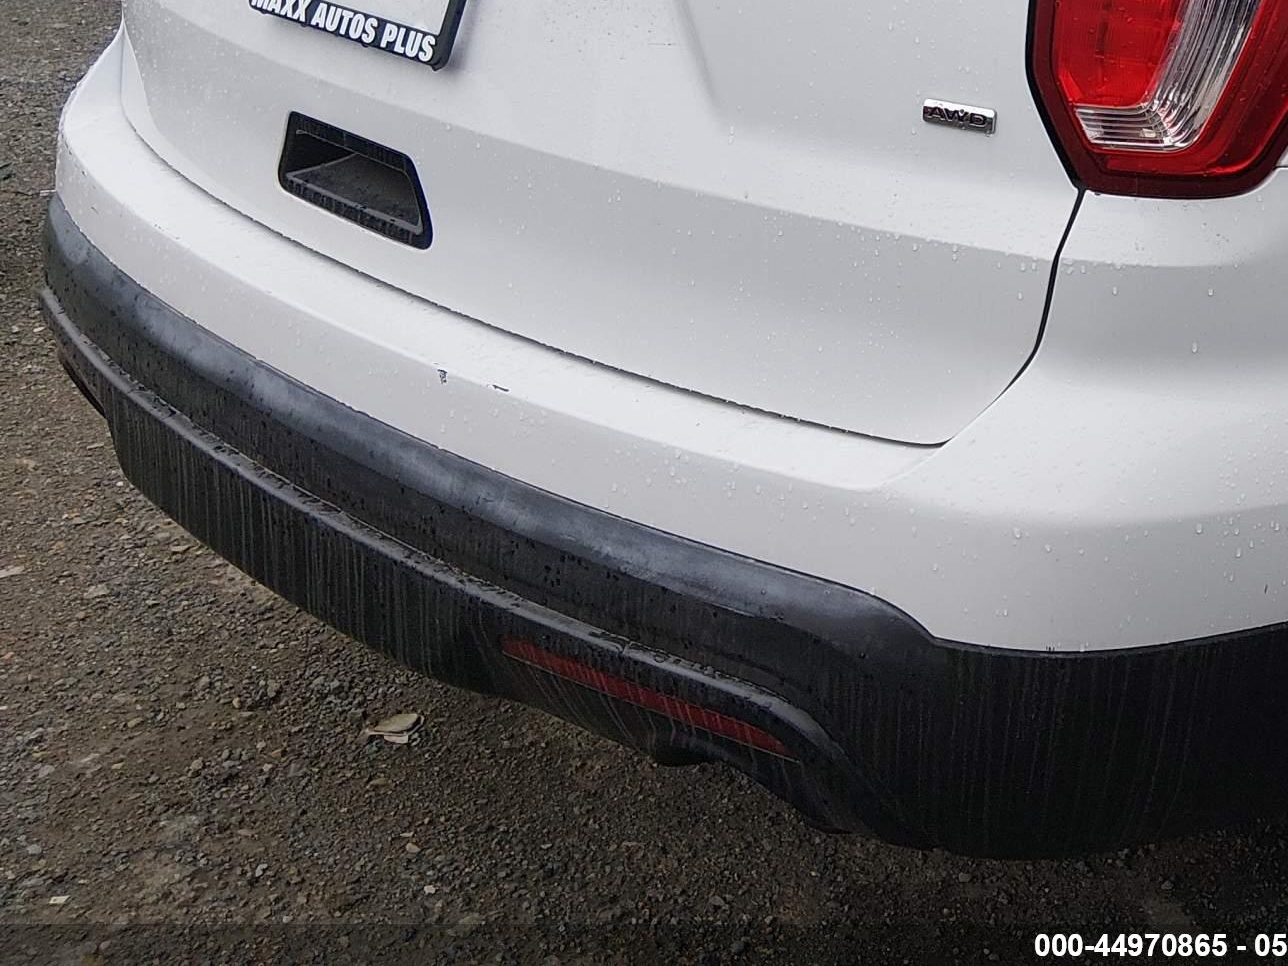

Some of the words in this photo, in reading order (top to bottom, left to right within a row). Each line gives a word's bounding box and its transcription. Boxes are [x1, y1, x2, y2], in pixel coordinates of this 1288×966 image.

[311, 0, 378, 44] AUTOS
[379, 23, 437, 63] PLUS
[926, 106, 988, 128] AWD
